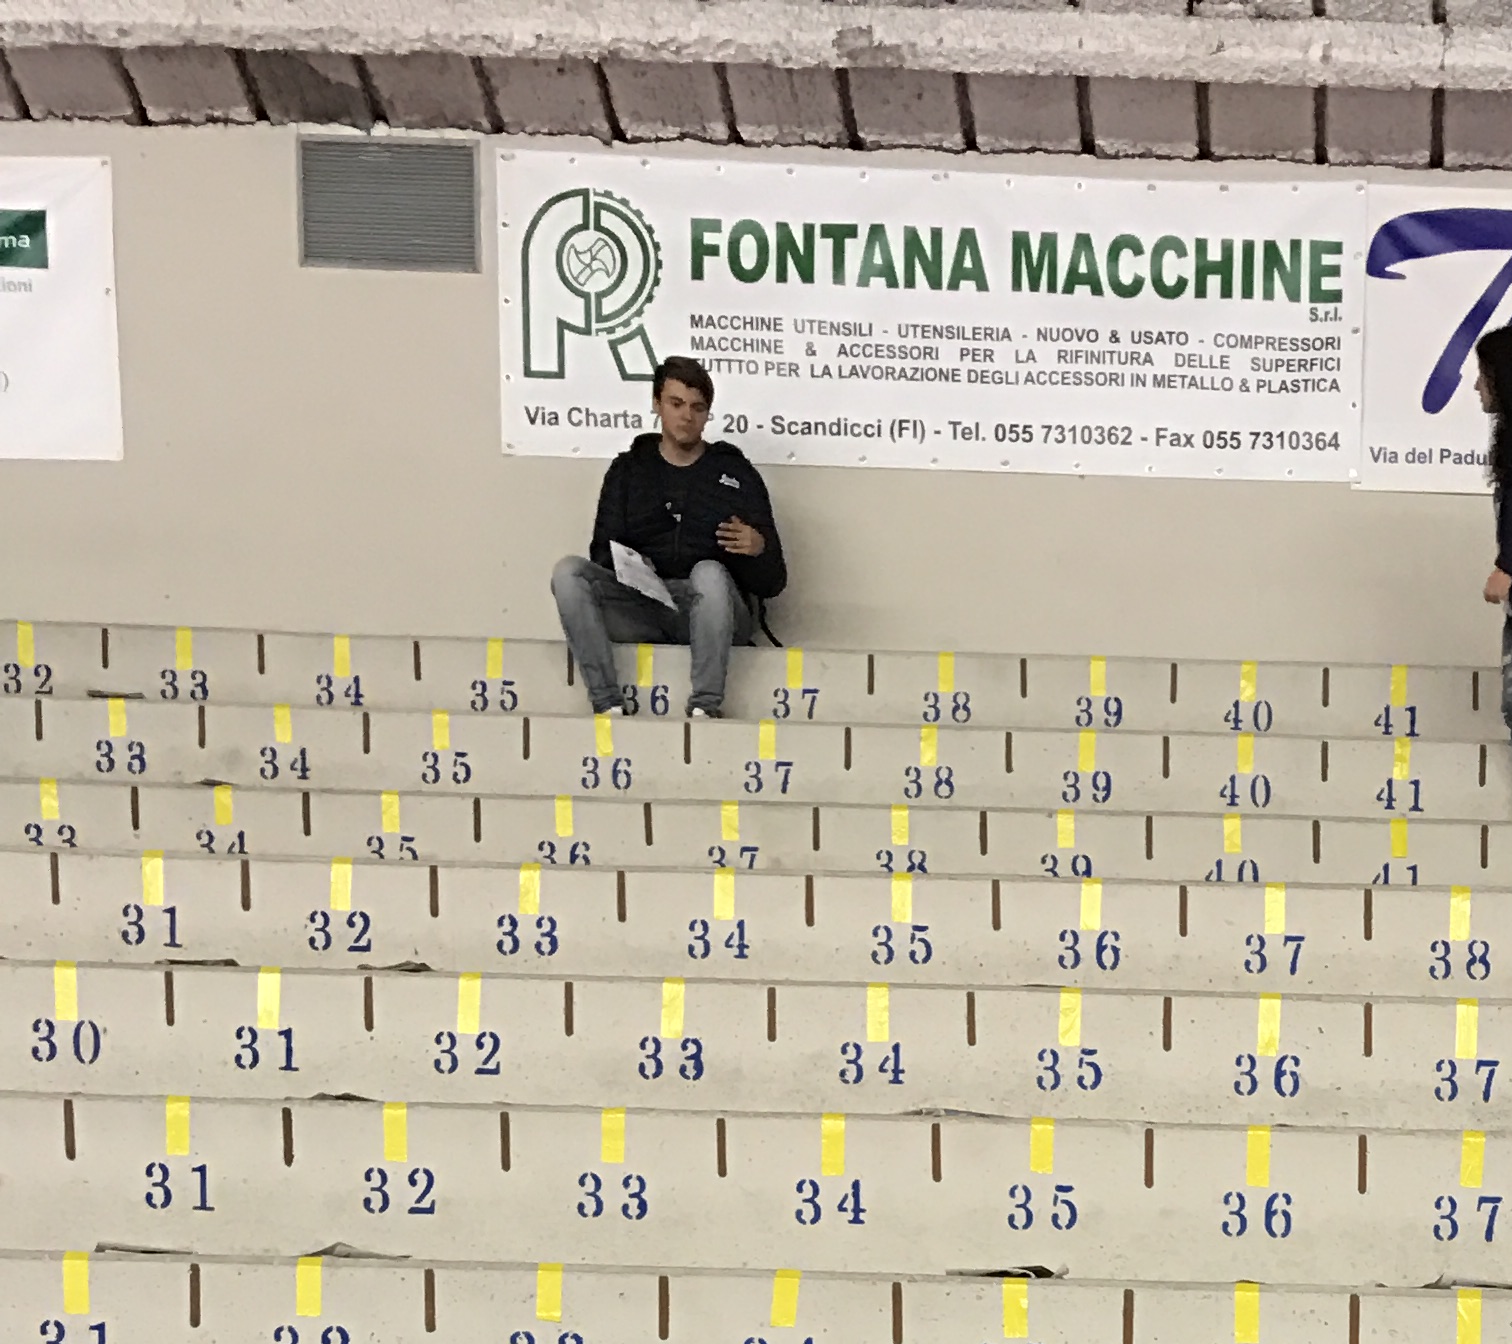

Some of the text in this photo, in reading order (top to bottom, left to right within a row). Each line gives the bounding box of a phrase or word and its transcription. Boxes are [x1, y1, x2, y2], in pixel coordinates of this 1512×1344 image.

[690, 217, 1344, 303] FONTANA MACCHINE
[690, 314, 1342, 352] MACCHINE UTENSILI UTENSILERIA NUOVO & USATO COMPRESSORI
[1309, 307, 1343, 322] S.r.l.
[690, 336, 1342, 373] MACCHINE & ACCESSORI PER LA RIFINITURA DELLE SUPERFICI
[693, 358, 1341, 394] UTTTO PER LA LAVORAZIONE DEGLI ACCESSORI IN METALLO & PLASTICA
[524, 405, 559, 427] Via
[567, 406, 643, 429] Charta
[722, 413, 749, 435] 20
[771, 415, 883, 438] Scandicci
[889, 418, 926, 444] (FI)
[948, 420, 986, 442] Tel.
[994, 423, 1034, 443] 055
[1041, 425, 1133, 446] 7310362
[1155, 427, 1195, 448] Fax
[1202, 430, 1242, 450] 055
[1250, 431, 1341, 451] 7310364
[1369, 446, 1400, 466] Via
[1404, 447, 1433, 465] del
[3, 662, 53, 692] 32
[315, 672, 364, 708] 34
[921, 691, 972, 723] 38
[1223, 699, 1273, 733] 40
[259, 746, 310, 781] 34
[580, 755, 633, 790] 36
[1218, 773, 1272, 808] 40
[120, 903, 182, 949] 31
[495, 913, 560, 958] 33
[1243, 933, 1307, 977] 37
[233, 1025, 299, 1073] 31
[637, 1035, 705, 1082] 33
[1433, 1058, 1501, 1103] 37
[144, 1161, 214, 1212] 31
[576, 1171, 649, 1221] 33
[1006, 1183, 1078, 1231] 35
[1432, 1195, 1504, 1243] 37
